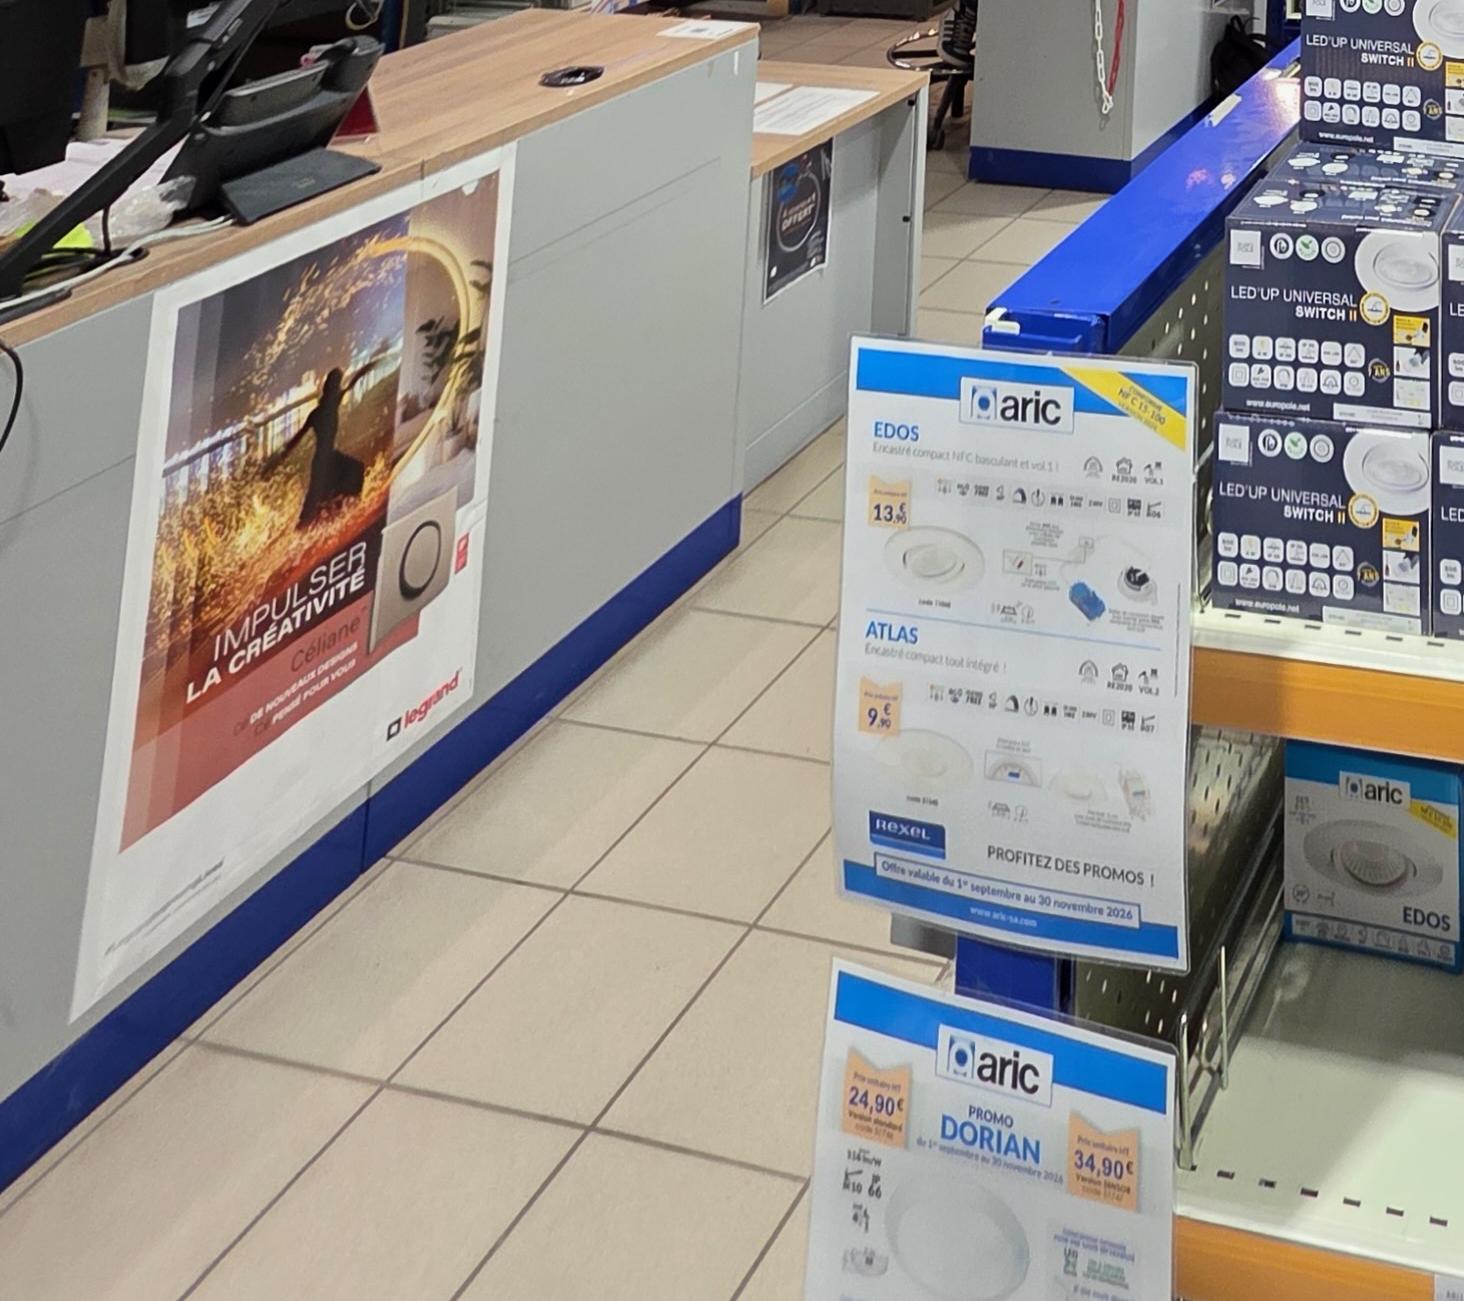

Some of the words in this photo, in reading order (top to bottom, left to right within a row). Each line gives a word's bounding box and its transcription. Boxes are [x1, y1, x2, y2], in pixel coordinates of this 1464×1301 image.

[1306, 33, 1348, 49] LED'UP
[1350, 37, 1415, 56] UNIVERSAL
[1361, 53, 1405, 67] SWITCH
[1231, 285, 1280, 303] LED'UP
[1283, 289, 1357, 307] UNIVERSAL
[1295, 306, 1346, 321] SWITCH
[1000, 389, 1062, 426] aric
[873, 420, 921, 444] EDOS
[1219, 482, 1268, 501] LED'UP
[1271, 487, 1346, 510] UNIVERSAL
[1284, 505, 1334, 523] SWITCH
[214, 541, 367, 661] IMPULSER
[186, 673, 222, 704] LA
[228, 568, 365, 675] CRÉATIVITÉ
[290, 617, 361, 673] Céliane
[866, 620, 919, 645] ATLAS
[404, 675, 460, 728] legrand
[1364, 779, 1403, 805] aric
[987, 845, 1053, 872] PROFITEZ
[1055, 855, 1081, 877] DES
[1083, 861, 1144, 886] PROMOS
[908, 867, 940, 886] valable
[943, 876, 955, 889] du
[970, 883, 1022, 903] septembre
[1024, 893, 1036, 905] au
[1038, 894, 1052, 907] 30
[1053, 898, 1104, 916] novembre
[1402, 905, 1451, 933] EDOS
[976, 1049, 1040, 1095] aric
[968, 1103, 1014, 1129] PROMO
[940, 1114, 1041, 1164] DORIAN
